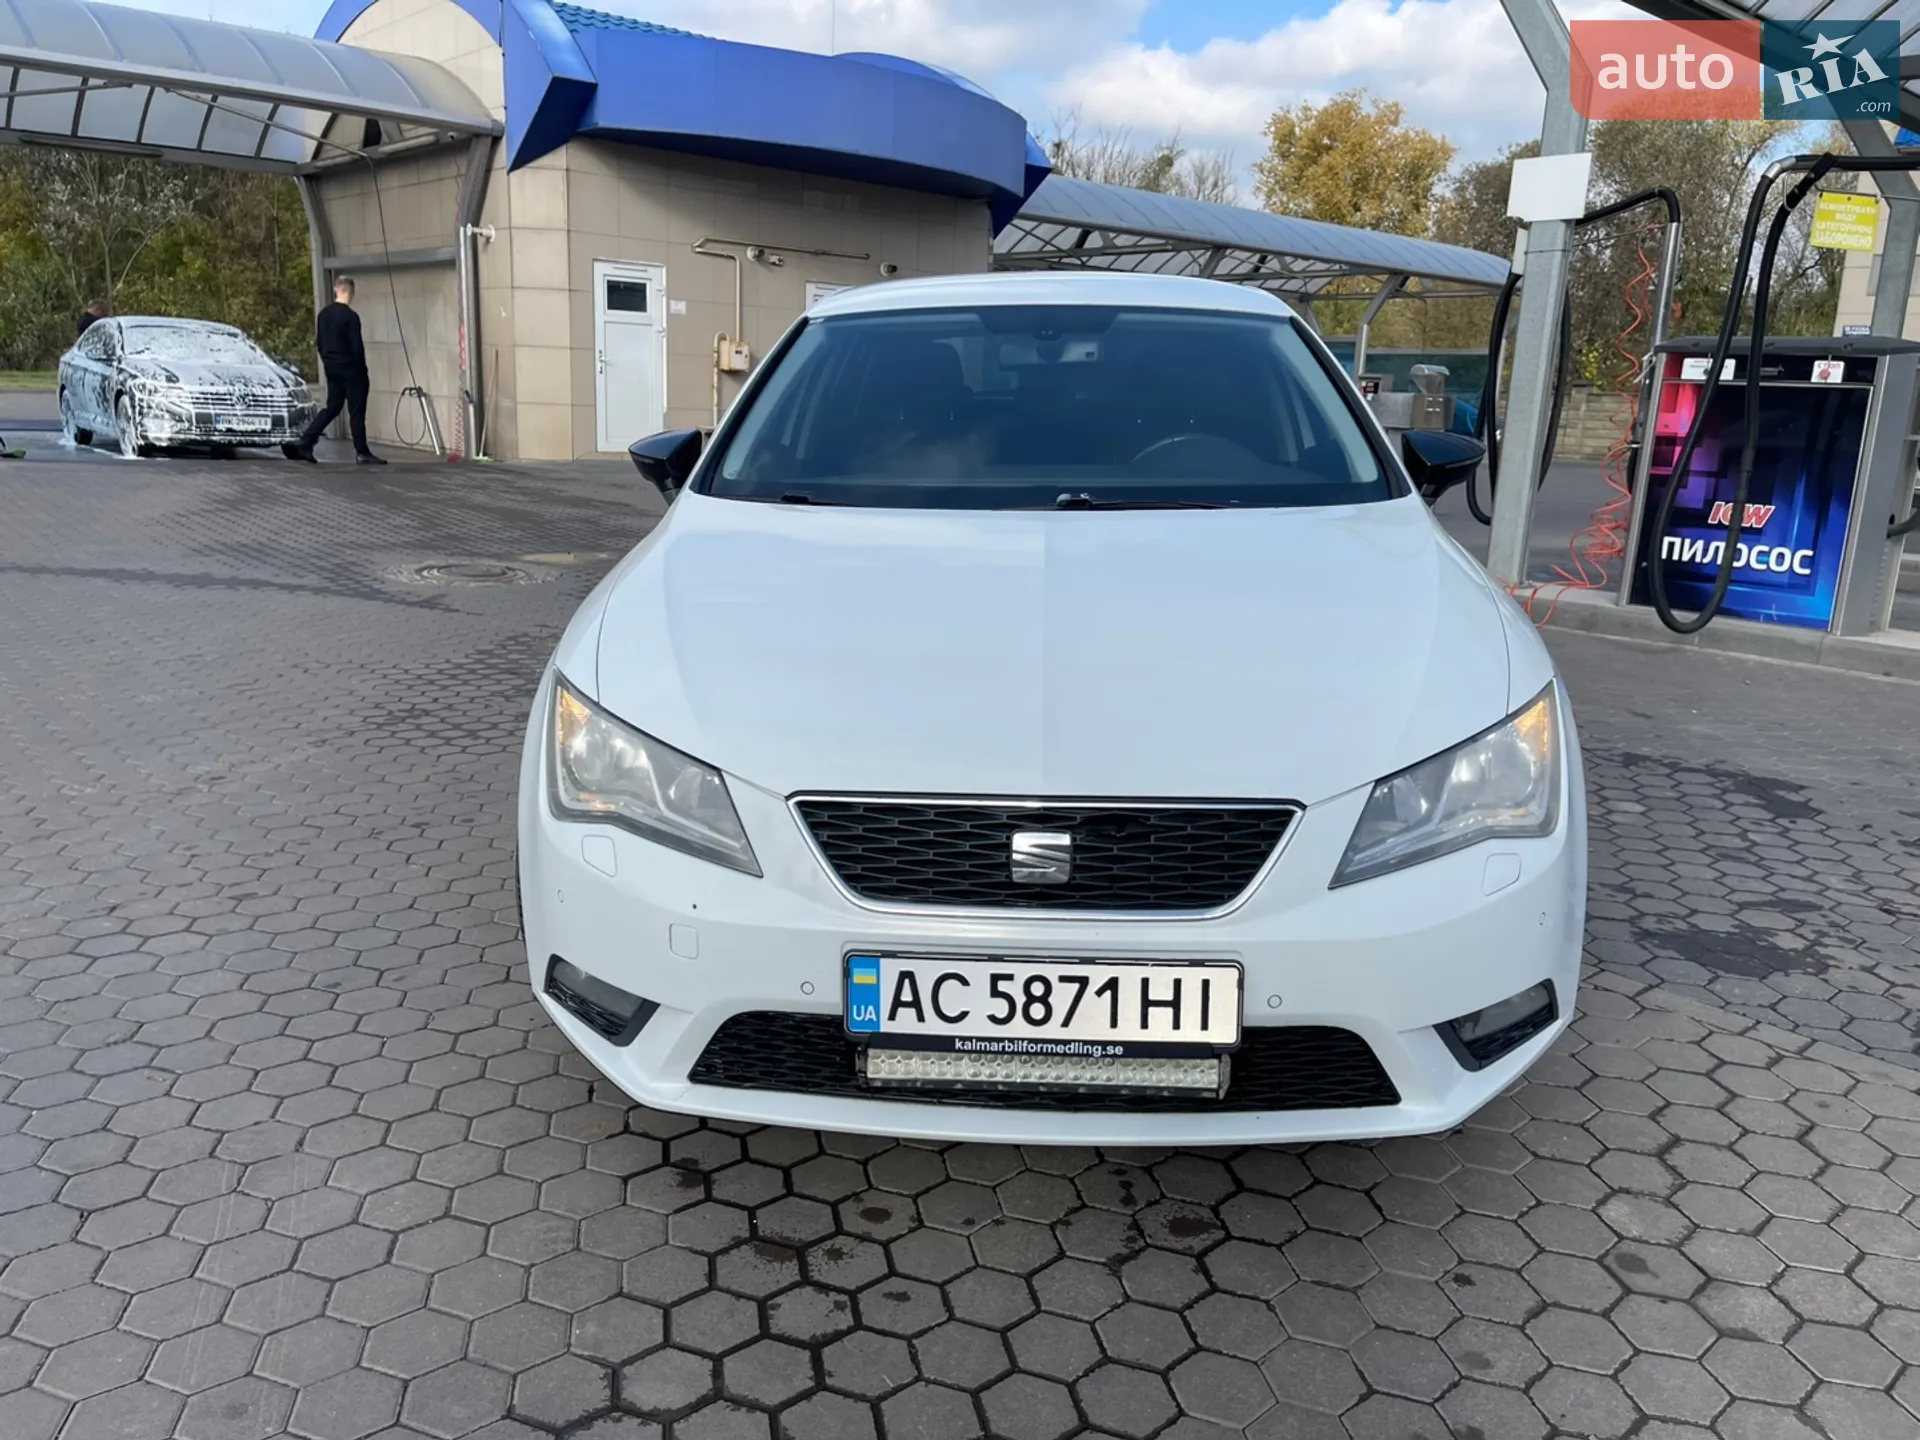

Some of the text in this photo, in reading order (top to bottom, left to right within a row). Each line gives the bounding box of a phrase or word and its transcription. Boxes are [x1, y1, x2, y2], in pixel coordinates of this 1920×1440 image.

[1661, 536, 1814, 575] ПИЛОСОС
[853, 1005, 877, 1021] UA
[887, 970, 1210, 1031] AC 5871 HI
[955, 1038, 1124, 1056] kalmarbilformedling.se
